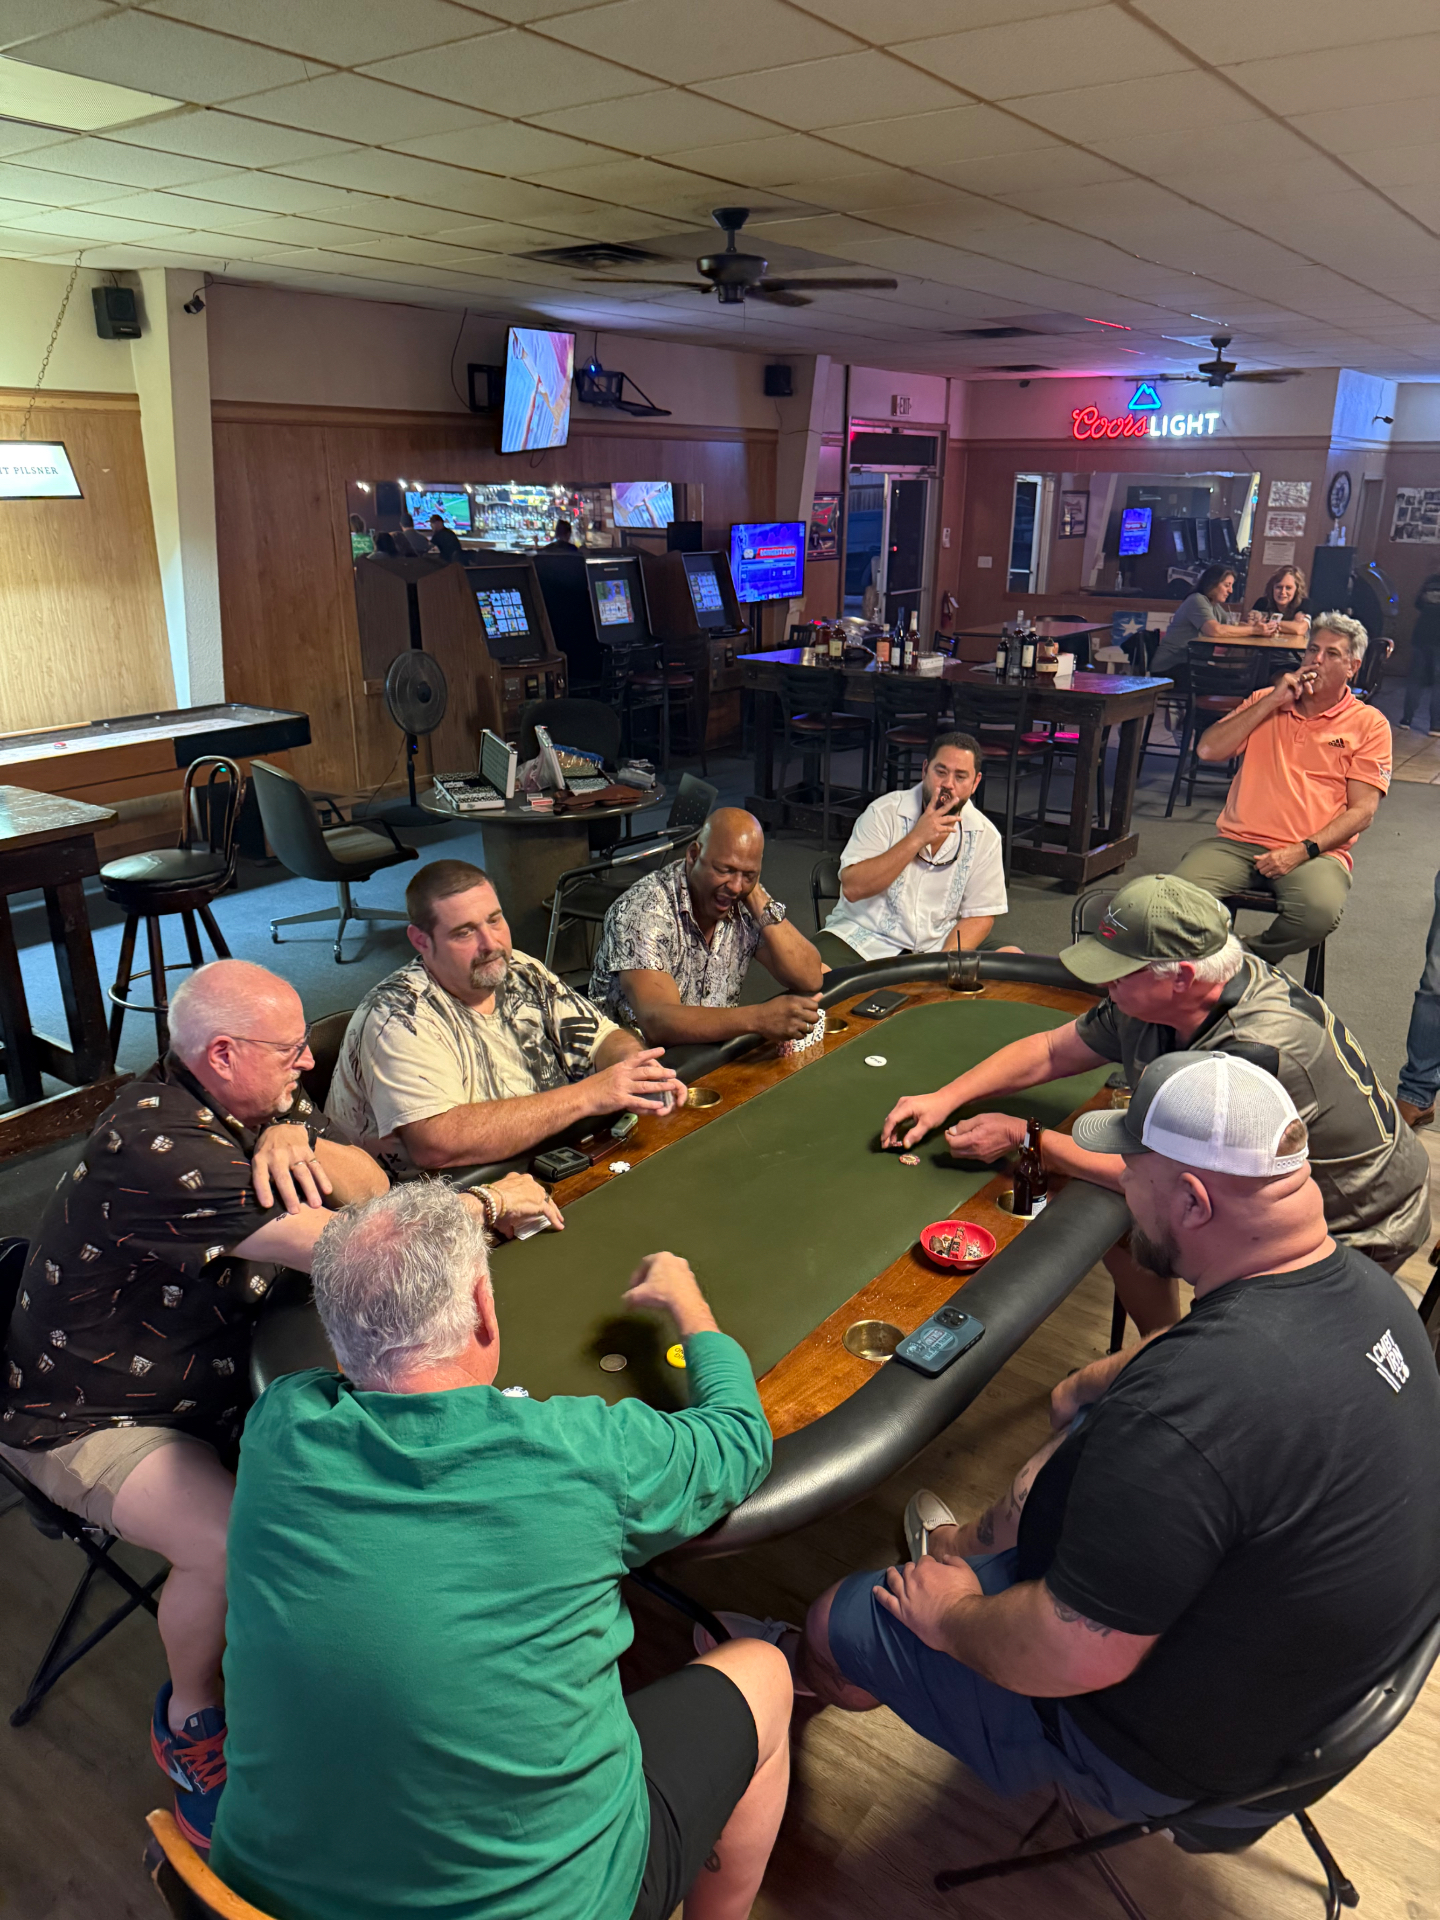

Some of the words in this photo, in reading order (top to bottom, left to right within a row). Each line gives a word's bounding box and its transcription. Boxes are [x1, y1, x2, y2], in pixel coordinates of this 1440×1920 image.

[1072, 406, 1149, 440] Coors
[1150, 413, 1219, 436] LIGHT
[13, 467, 59, 475] PILSNER
[1372, 1328, 1394, 1363] CMBT
[1386, 1343, 1404, 1374] IRN
